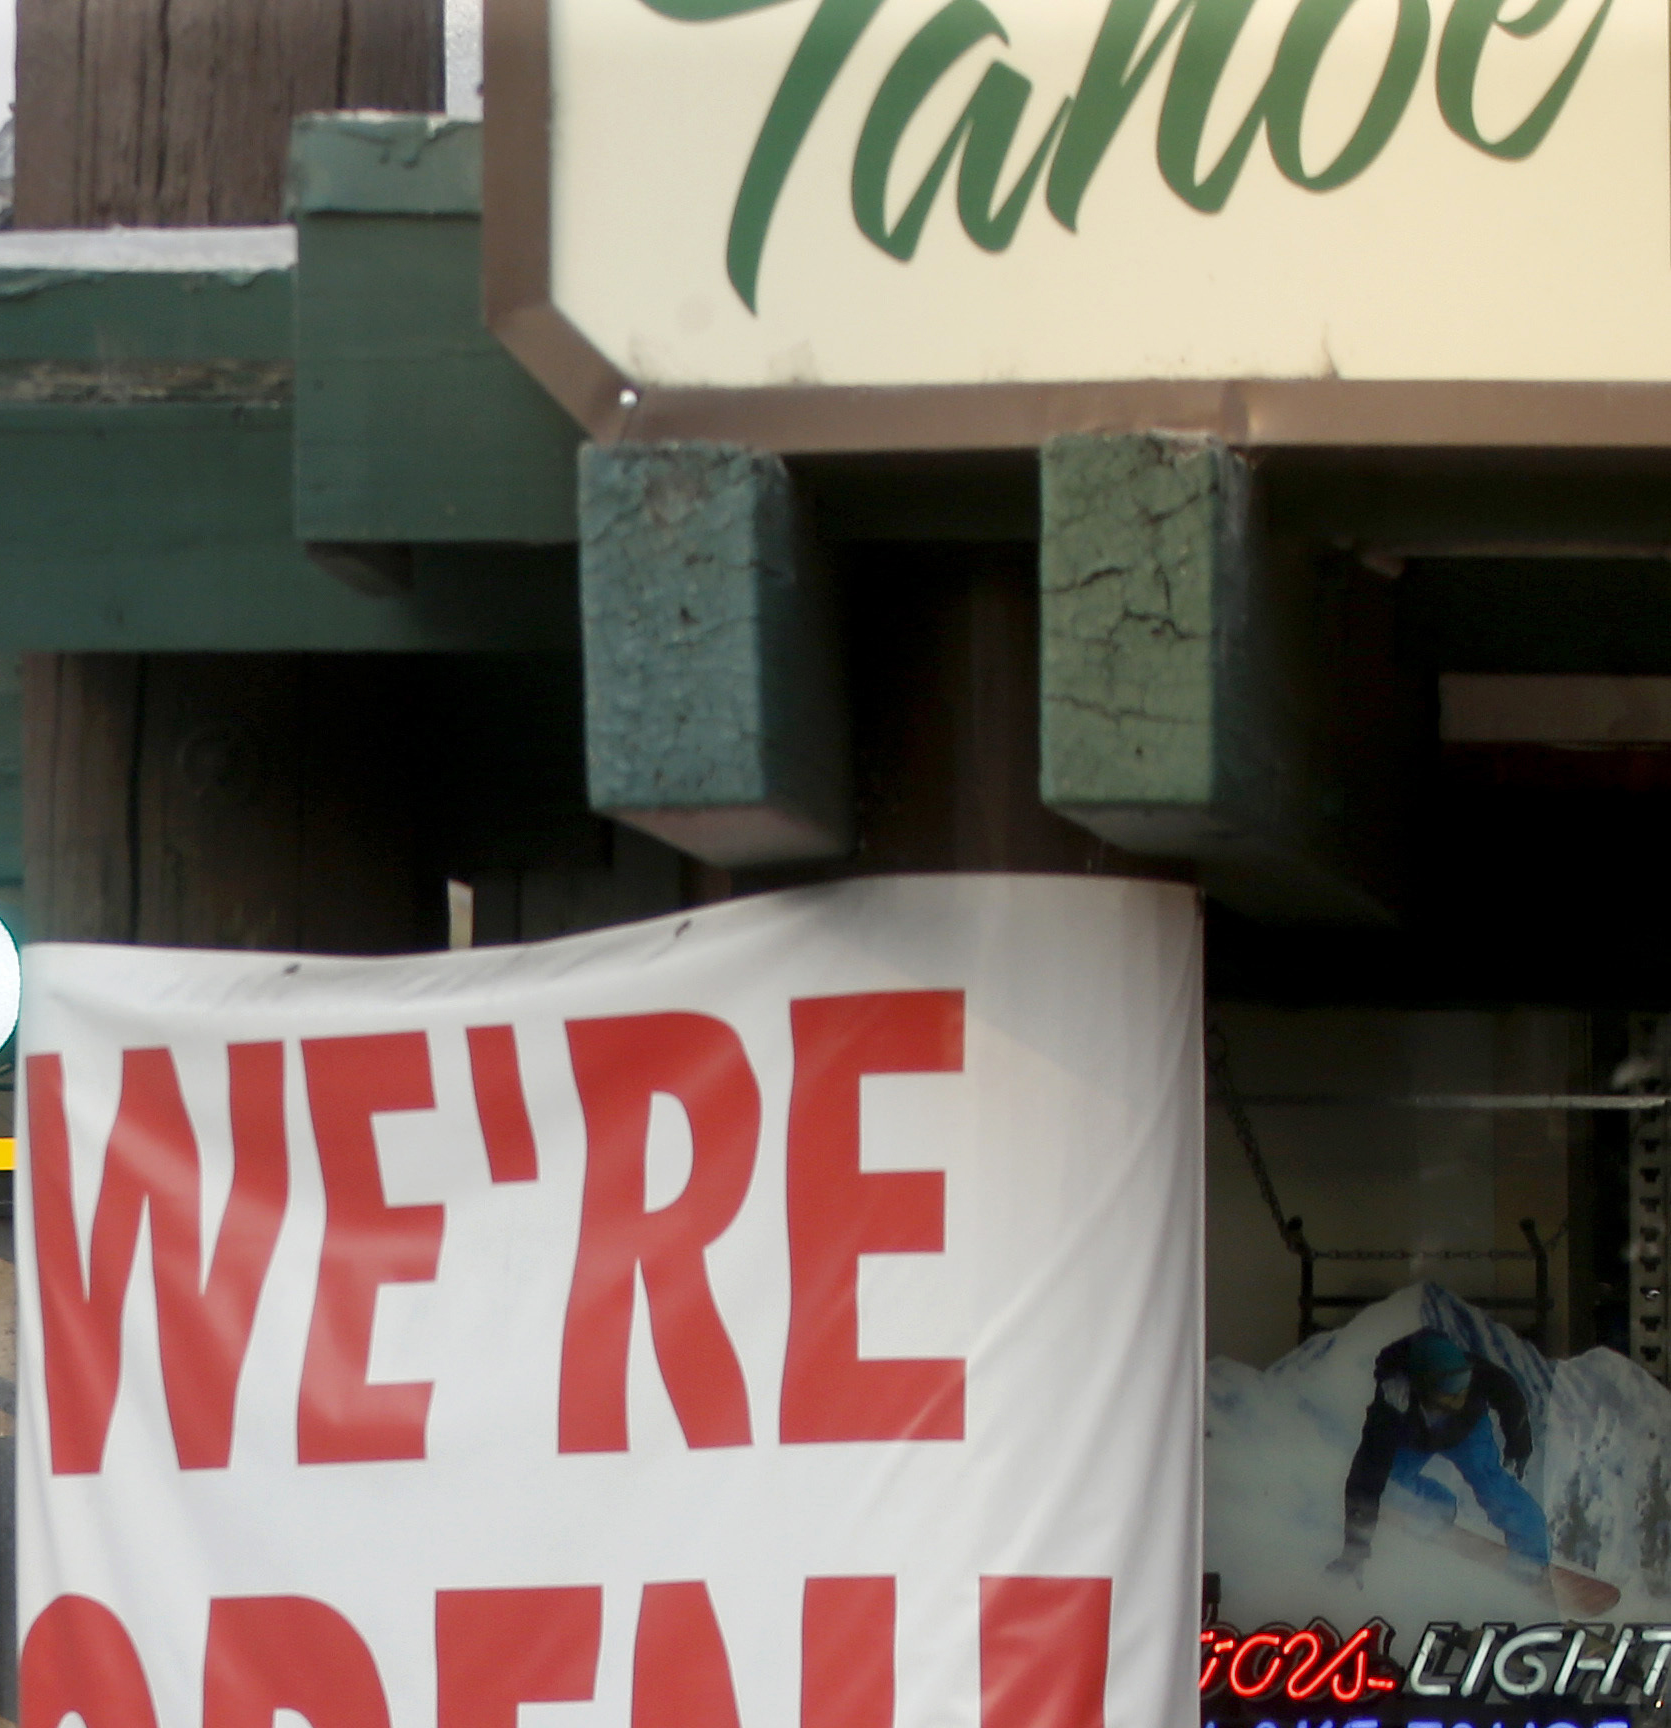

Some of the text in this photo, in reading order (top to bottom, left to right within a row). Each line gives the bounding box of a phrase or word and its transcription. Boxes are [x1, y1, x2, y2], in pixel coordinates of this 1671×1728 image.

[637, 0, 1615, 318] Tahoe
[25, 988, 966, 1476] WE'RE
[1408, 1627, 1671, 1698] LIGHT
